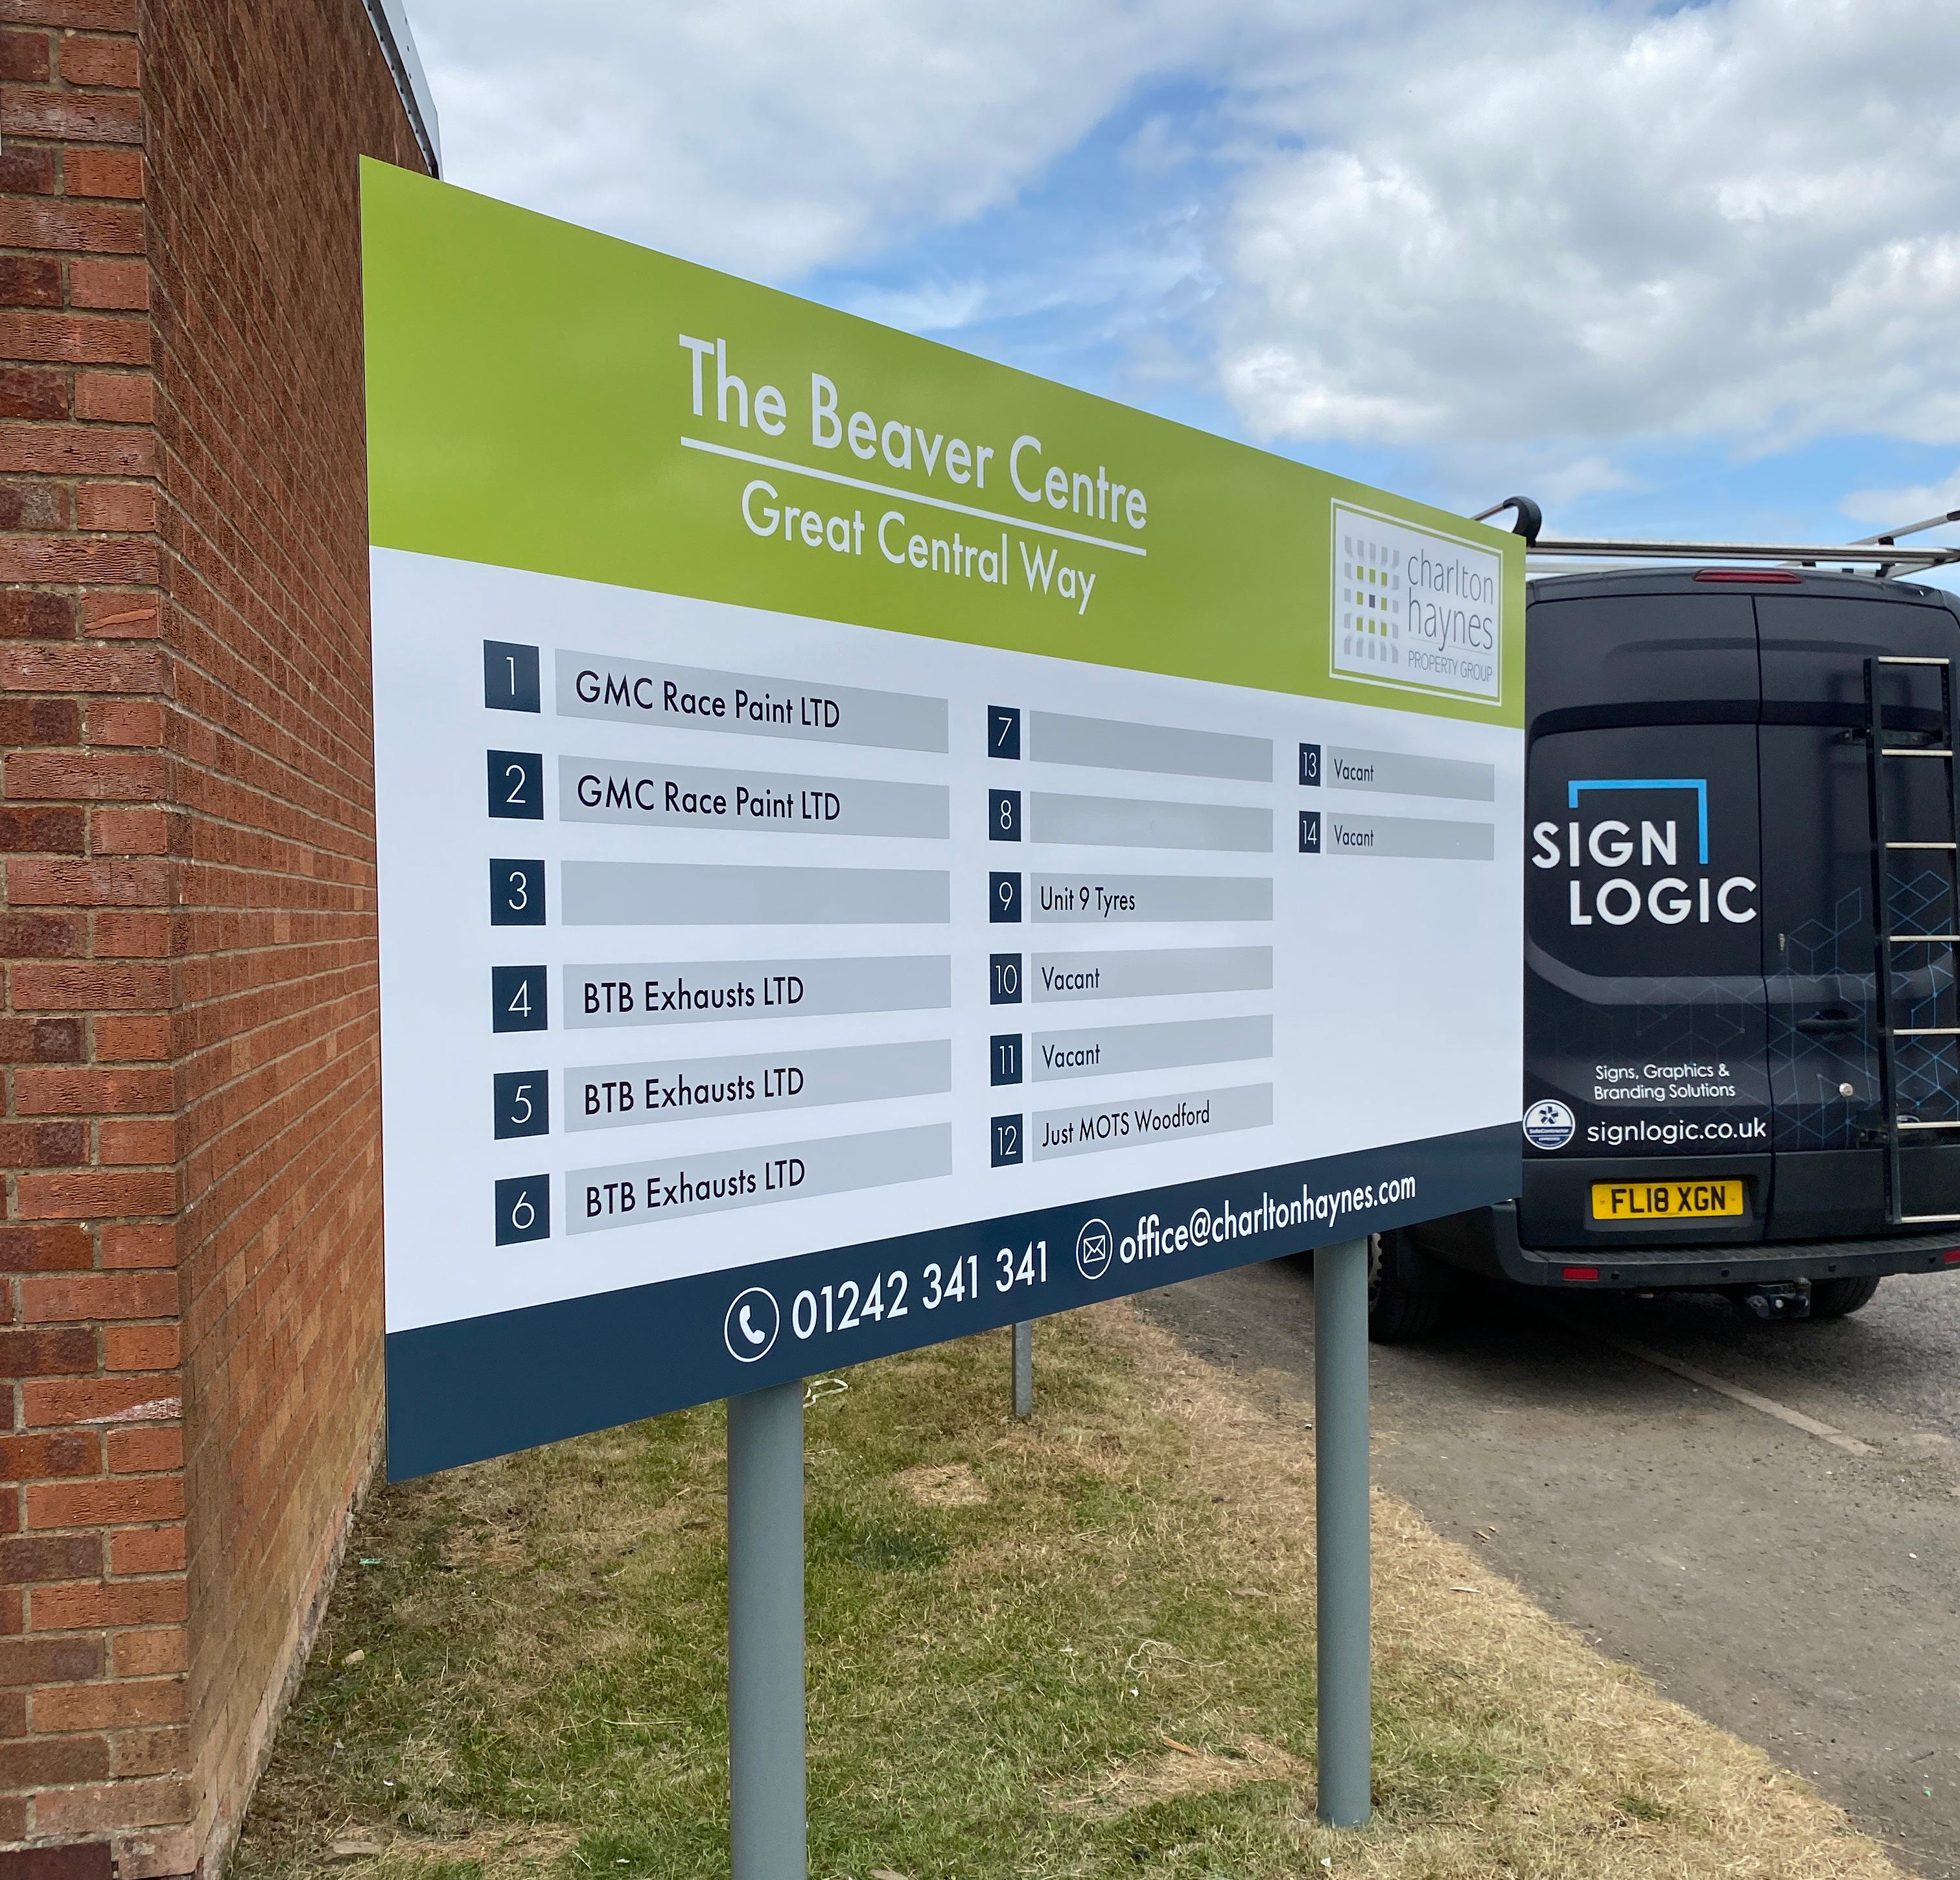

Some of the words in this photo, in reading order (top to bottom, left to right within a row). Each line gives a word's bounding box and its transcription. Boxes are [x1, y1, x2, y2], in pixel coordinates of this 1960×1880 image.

[679, 334, 787, 436] The
[811, 372, 994, 490] Beaver
[1009, 435, 1147, 529] Centre
[741, 480, 865, 555] Great
[878, 511, 1008, 585] Central
[1019, 541, 1097, 616] Way
[1407, 549, 1493, 605] charlton
[1408, 586, 1493, 652] haynes
[505, 656, 516, 696] 1
[1408, 650, 1458, 676] PROPERTY
[1460, 660, 1493, 682] GROUP
[576, 670, 653, 710] GMC
[664, 680, 726, 717] Race
[736, 689, 793, 724] Paint
[801, 697, 839, 728] LTD
[998, 717, 1012, 747] 7
[1303, 752, 1317, 778] 13
[1333, 758, 1374, 782] Vacant
[506, 765, 526, 804] 2
[578, 774, 655, 811] GMC
[665, 781, 727, 815] Race
[736, 786, 794, 818] Paint
[802, 791, 840, 820] LTD
[1000, 800, 1012, 830] 8
[1303, 820, 1317, 845] 14
[1333, 824, 1374, 847] Vacant
[1532, 820, 1677, 869] SIGN
[508, 871, 528, 910] 3
[999, 881, 1013, 911] 9
[1040, 886, 1074, 911] Unit
[1079, 886, 1090, 911] 9
[1095, 887, 1136, 918] Tyres
[1570, 876, 1757, 925] LOGIC
[508, 979, 532, 1017] 4
[585, 982, 634, 1014] BTB
[645, 977, 755, 1012] Exhausts
[764, 976, 804, 1006] LTD
[996, 964, 1018, 994] 10
[1041, 966, 1100, 992] Vacant
[999, 1045, 1014, 1074] 11
[1042, 1043, 1101, 1069] Vacant
[1595, 1065, 1639, 1083] Signs,
[1643, 1063, 1714, 1081] Graphics
[1718, 1063, 1731, 1077] &
[511, 1085, 532, 1124] 5
[585, 1081, 634, 1115] BTB
[646, 1074, 755, 1109] Exhausts
[764, 1067, 804, 1098] LTD
[1594, 1084, 1666, 1102] Branding
[1669, 1082, 1736, 1098] Solutions
[998, 1125, 1017, 1156] 12
[1042, 1122, 1074, 1147] Just
[1079, 1111, 1130, 1142] MOTS
[1134, 1099, 1209, 1133] Woodford
[1587, 1117, 1766, 1146] signlogic.co.uk
[587, 1181, 636, 1218] BTB
[647, 1169, 756, 1209] Exhausts
[765, 1158, 805, 1190] LTD
[1611, 1187, 1669, 1214] FL18
[1677, 1185, 1725, 1212] XGN
[512, 1191, 535, 1229] 6
[1119, 1175, 1416, 1265] office@charltonhaynes.com
[792, 1270, 908, 1340] 01242
[922, 1255, 977, 1309] 341
[996, 1240, 1046, 1292] 341
